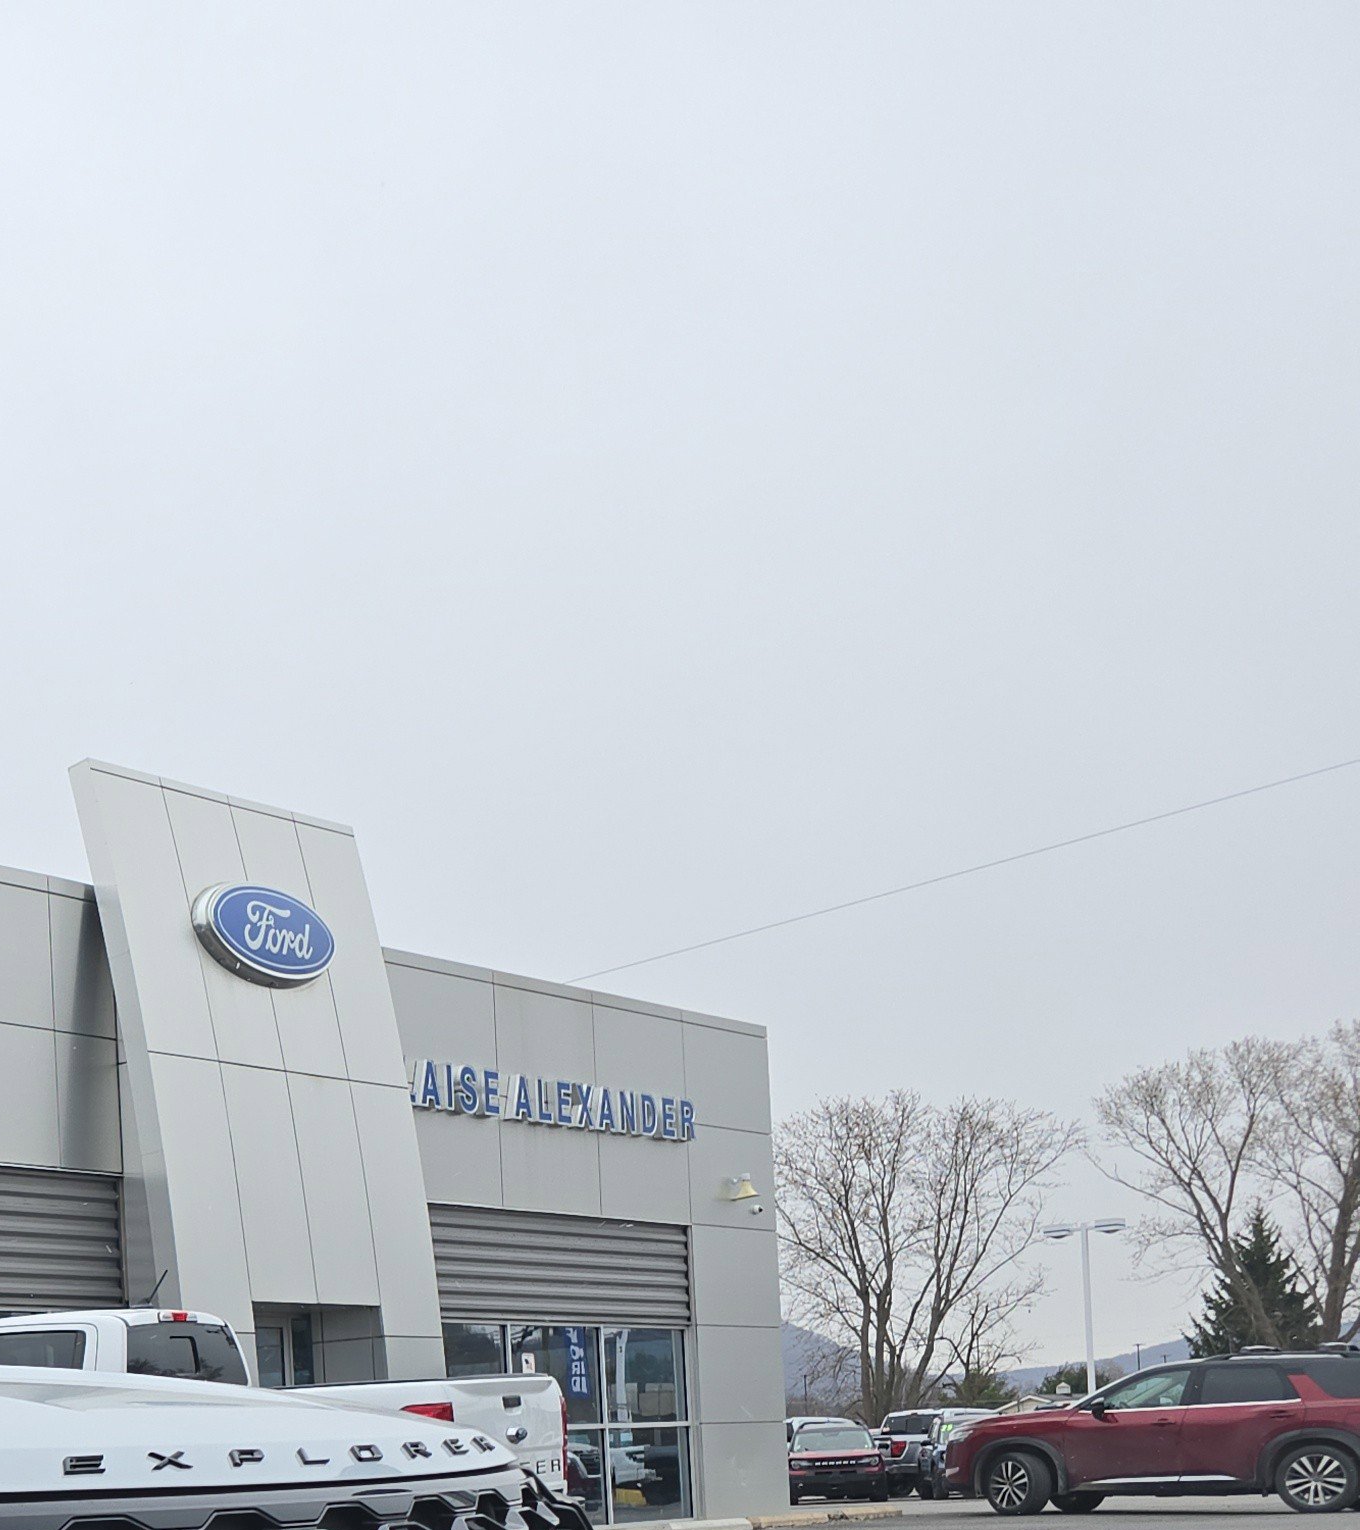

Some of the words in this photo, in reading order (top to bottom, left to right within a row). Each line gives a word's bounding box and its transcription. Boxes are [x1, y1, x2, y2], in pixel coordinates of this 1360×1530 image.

[244, 899, 313, 960] Ford
[508, 1073, 696, 1141] ALEXANDER
[61, 1434, 497, 1476] EXPLORER
[518, 1457, 562, 1475] ER
